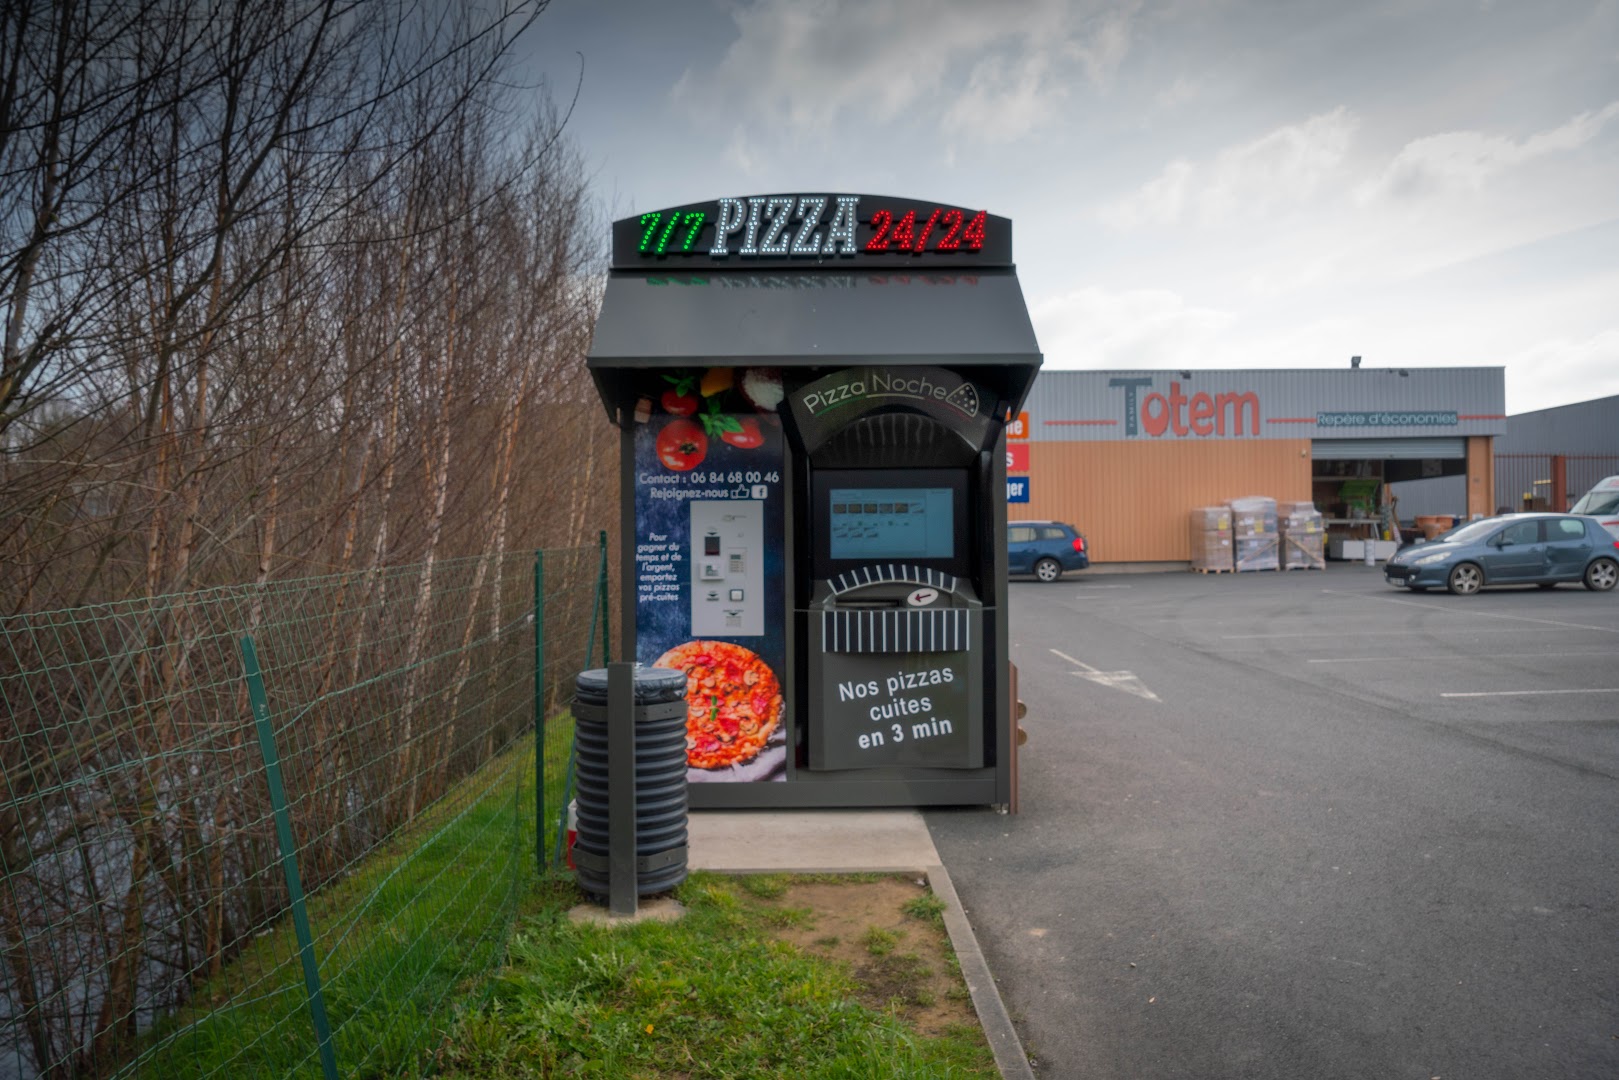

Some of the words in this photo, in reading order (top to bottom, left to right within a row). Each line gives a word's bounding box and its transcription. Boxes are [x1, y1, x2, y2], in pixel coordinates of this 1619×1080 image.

[638, 211, 706, 254] 7/7
[709, 196, 860, 256] PIZZA
[865, 208, 987, 252] 24/24
[803, 381, 866, 414] Pizza
[873, 374, 947, 400] Noche
[1108, 377, 1261, 437] Totem
[1317, 414, 1365, 427] Repère
[1368, 412, 1458, 425] d'économies
[640, 473, 680, 485] Contact
[690, 472, 706, 484] 06
[709, 472, 725, 484] 84
[727, 472, 743, 484] 68
[745, 472, 761, 484] 00
[764, 471, 780, 484] 46
[650, 487, 729, 501] Rejoignez-nous
[649, 532, 667, 541] Pour
[637, 544, 667, 553] gagner
[668, 542, 680, 551] du
[636, 553, 659, 563] temps
[660, 553, 669, 561] et
[671, 552, 682, 561] de
[640, 573, 677, 583] emportez
[654, 582, 680, 593] pizzas
[838, 681, 879, 702] Nos
[886, 667, 954, 696] pizzas
[869, 696, 932, 721] cuites
[858, 730, 885, 749] en
[891, 723, 905, 742] 3
[911, 717, 953, 739] min
